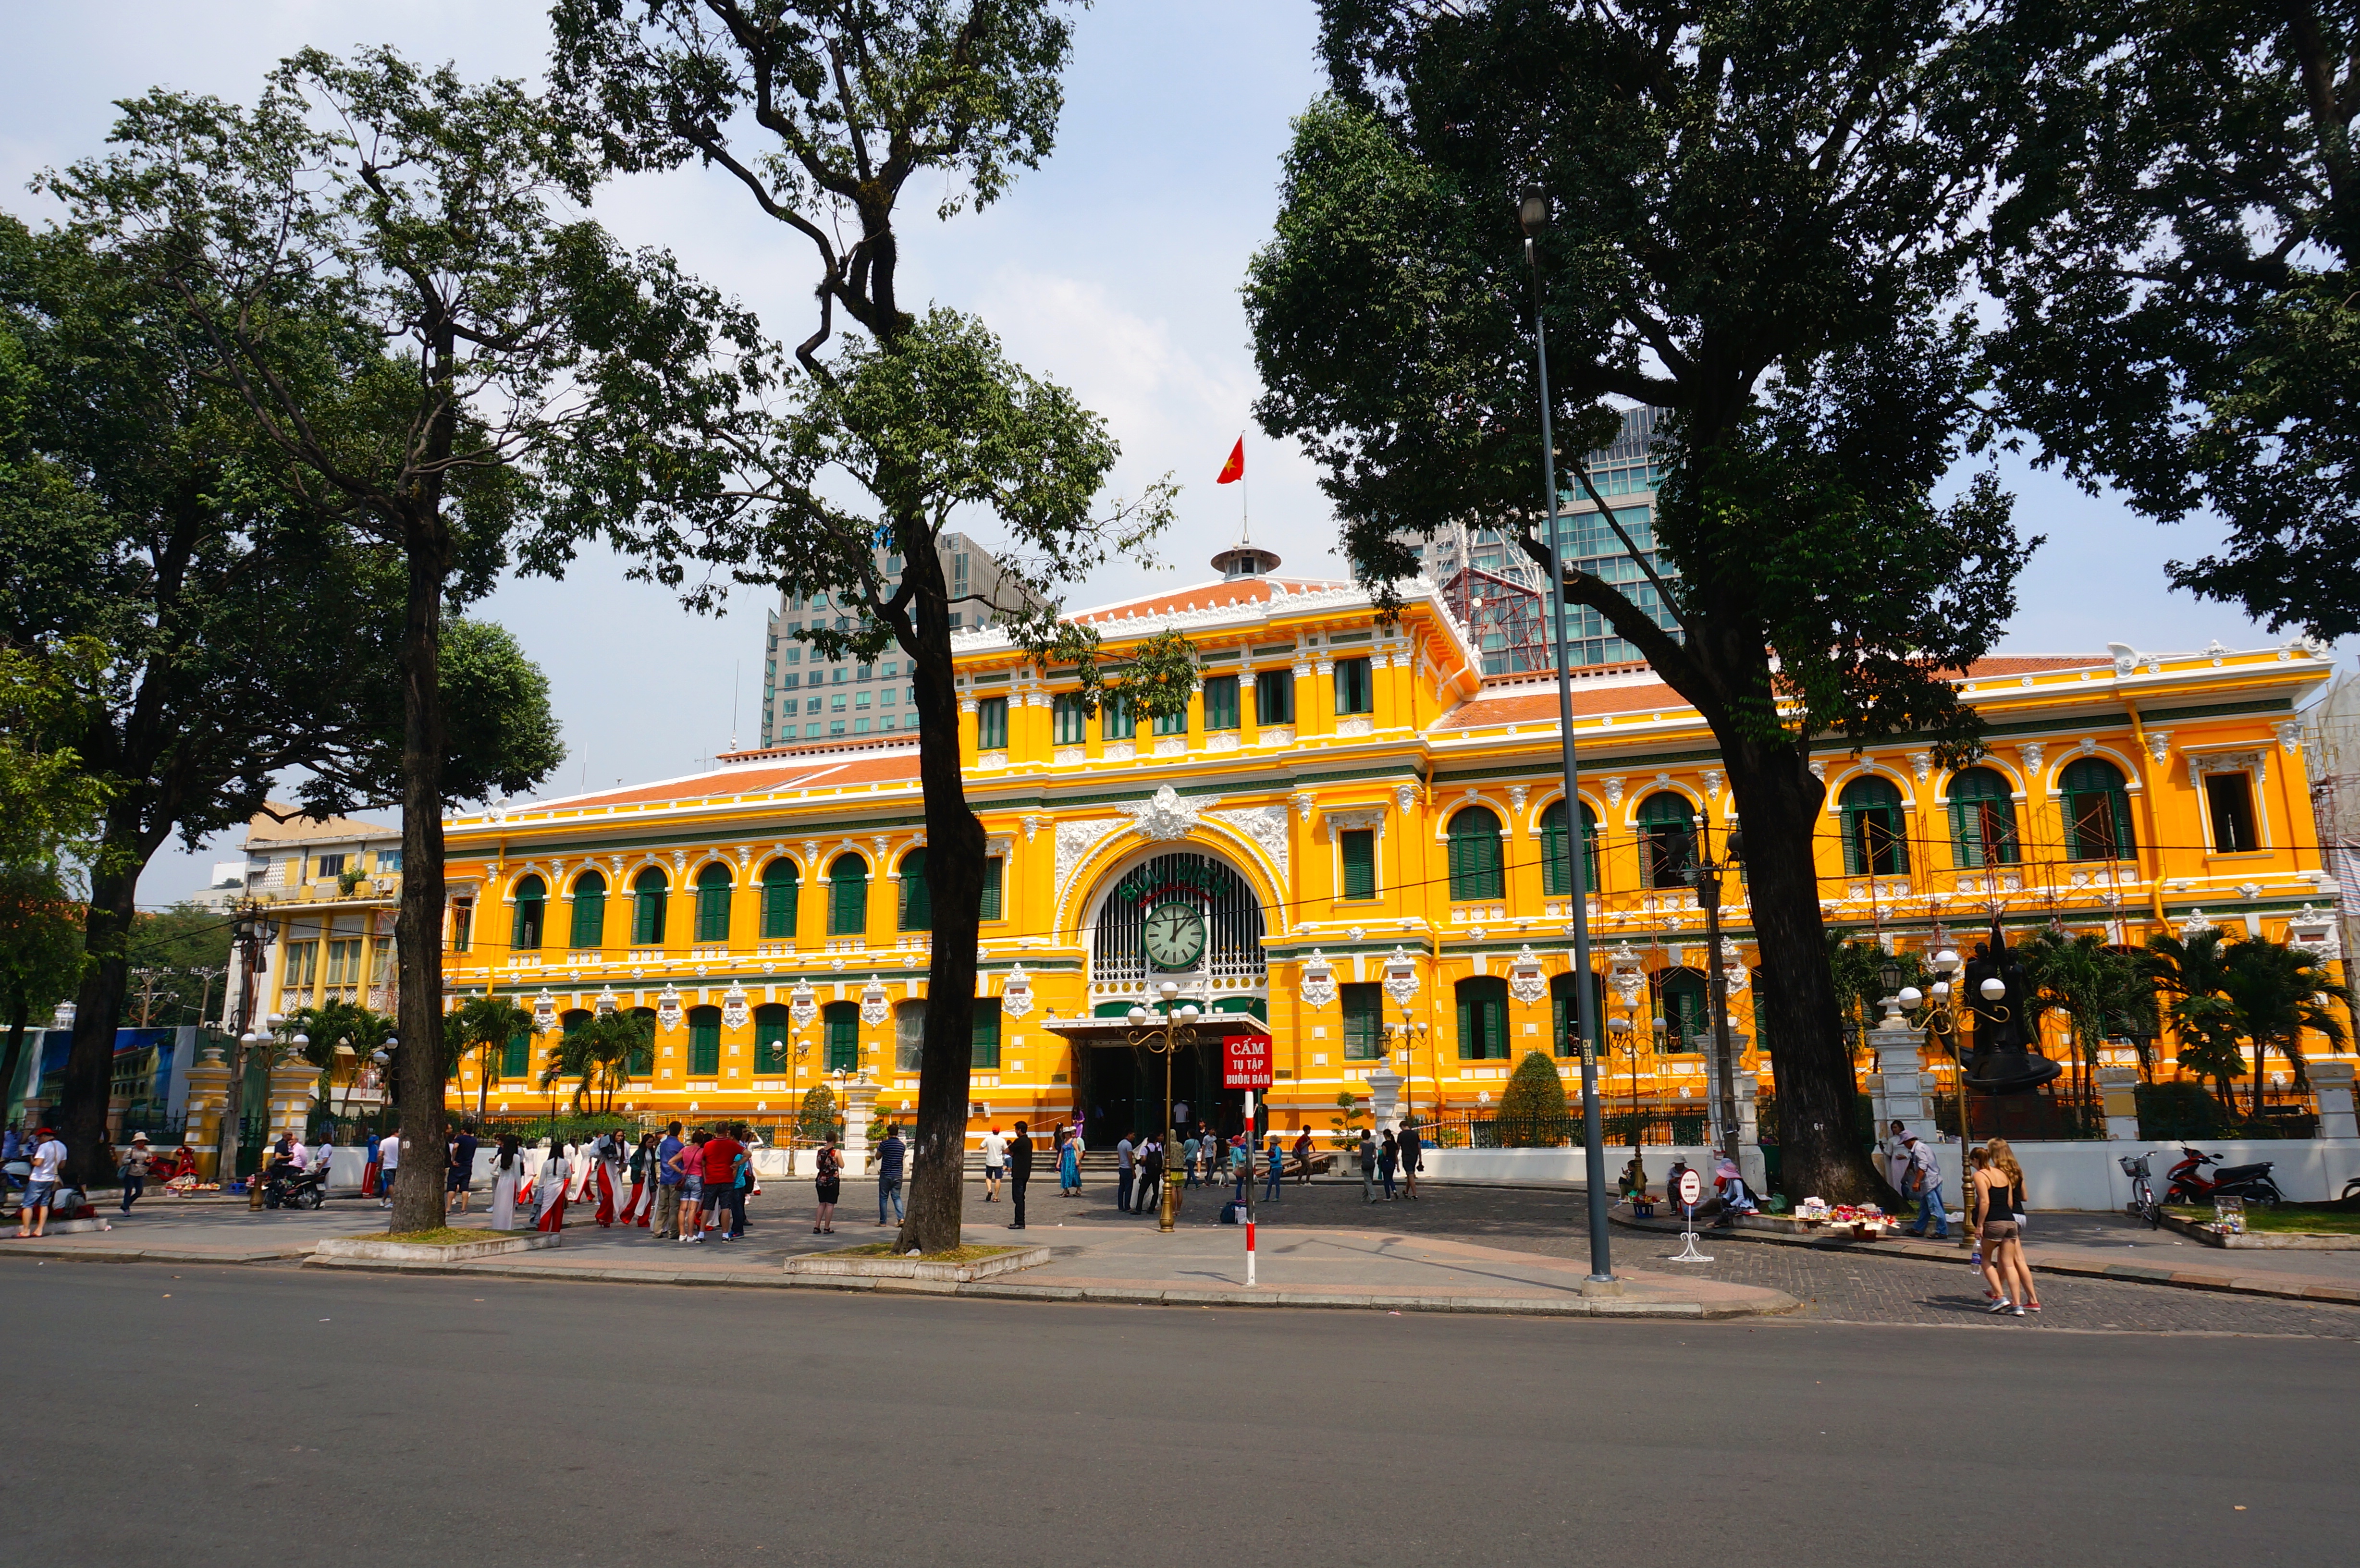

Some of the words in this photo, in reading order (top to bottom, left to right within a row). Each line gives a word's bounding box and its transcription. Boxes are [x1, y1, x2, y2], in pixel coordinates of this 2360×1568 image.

[1230, 1037, 1265, 1055] CẤM
[1583, 1039, 1592, 1047] CV
[1584, 1048, 1592, 1056] 31
[1232, 1060, 1244, 1072] TỤ
[1246, 1058, 1264, 1072] TẬP
[1584, 1057, 1594, 1065] 32
[1226, 1073, 1250, 1084] BUÔN
[1252, 1072, 1270, 1084] BÁN
[403, 1140, 410, 1149] 10
[920, 1145, 924, 1154] 8
